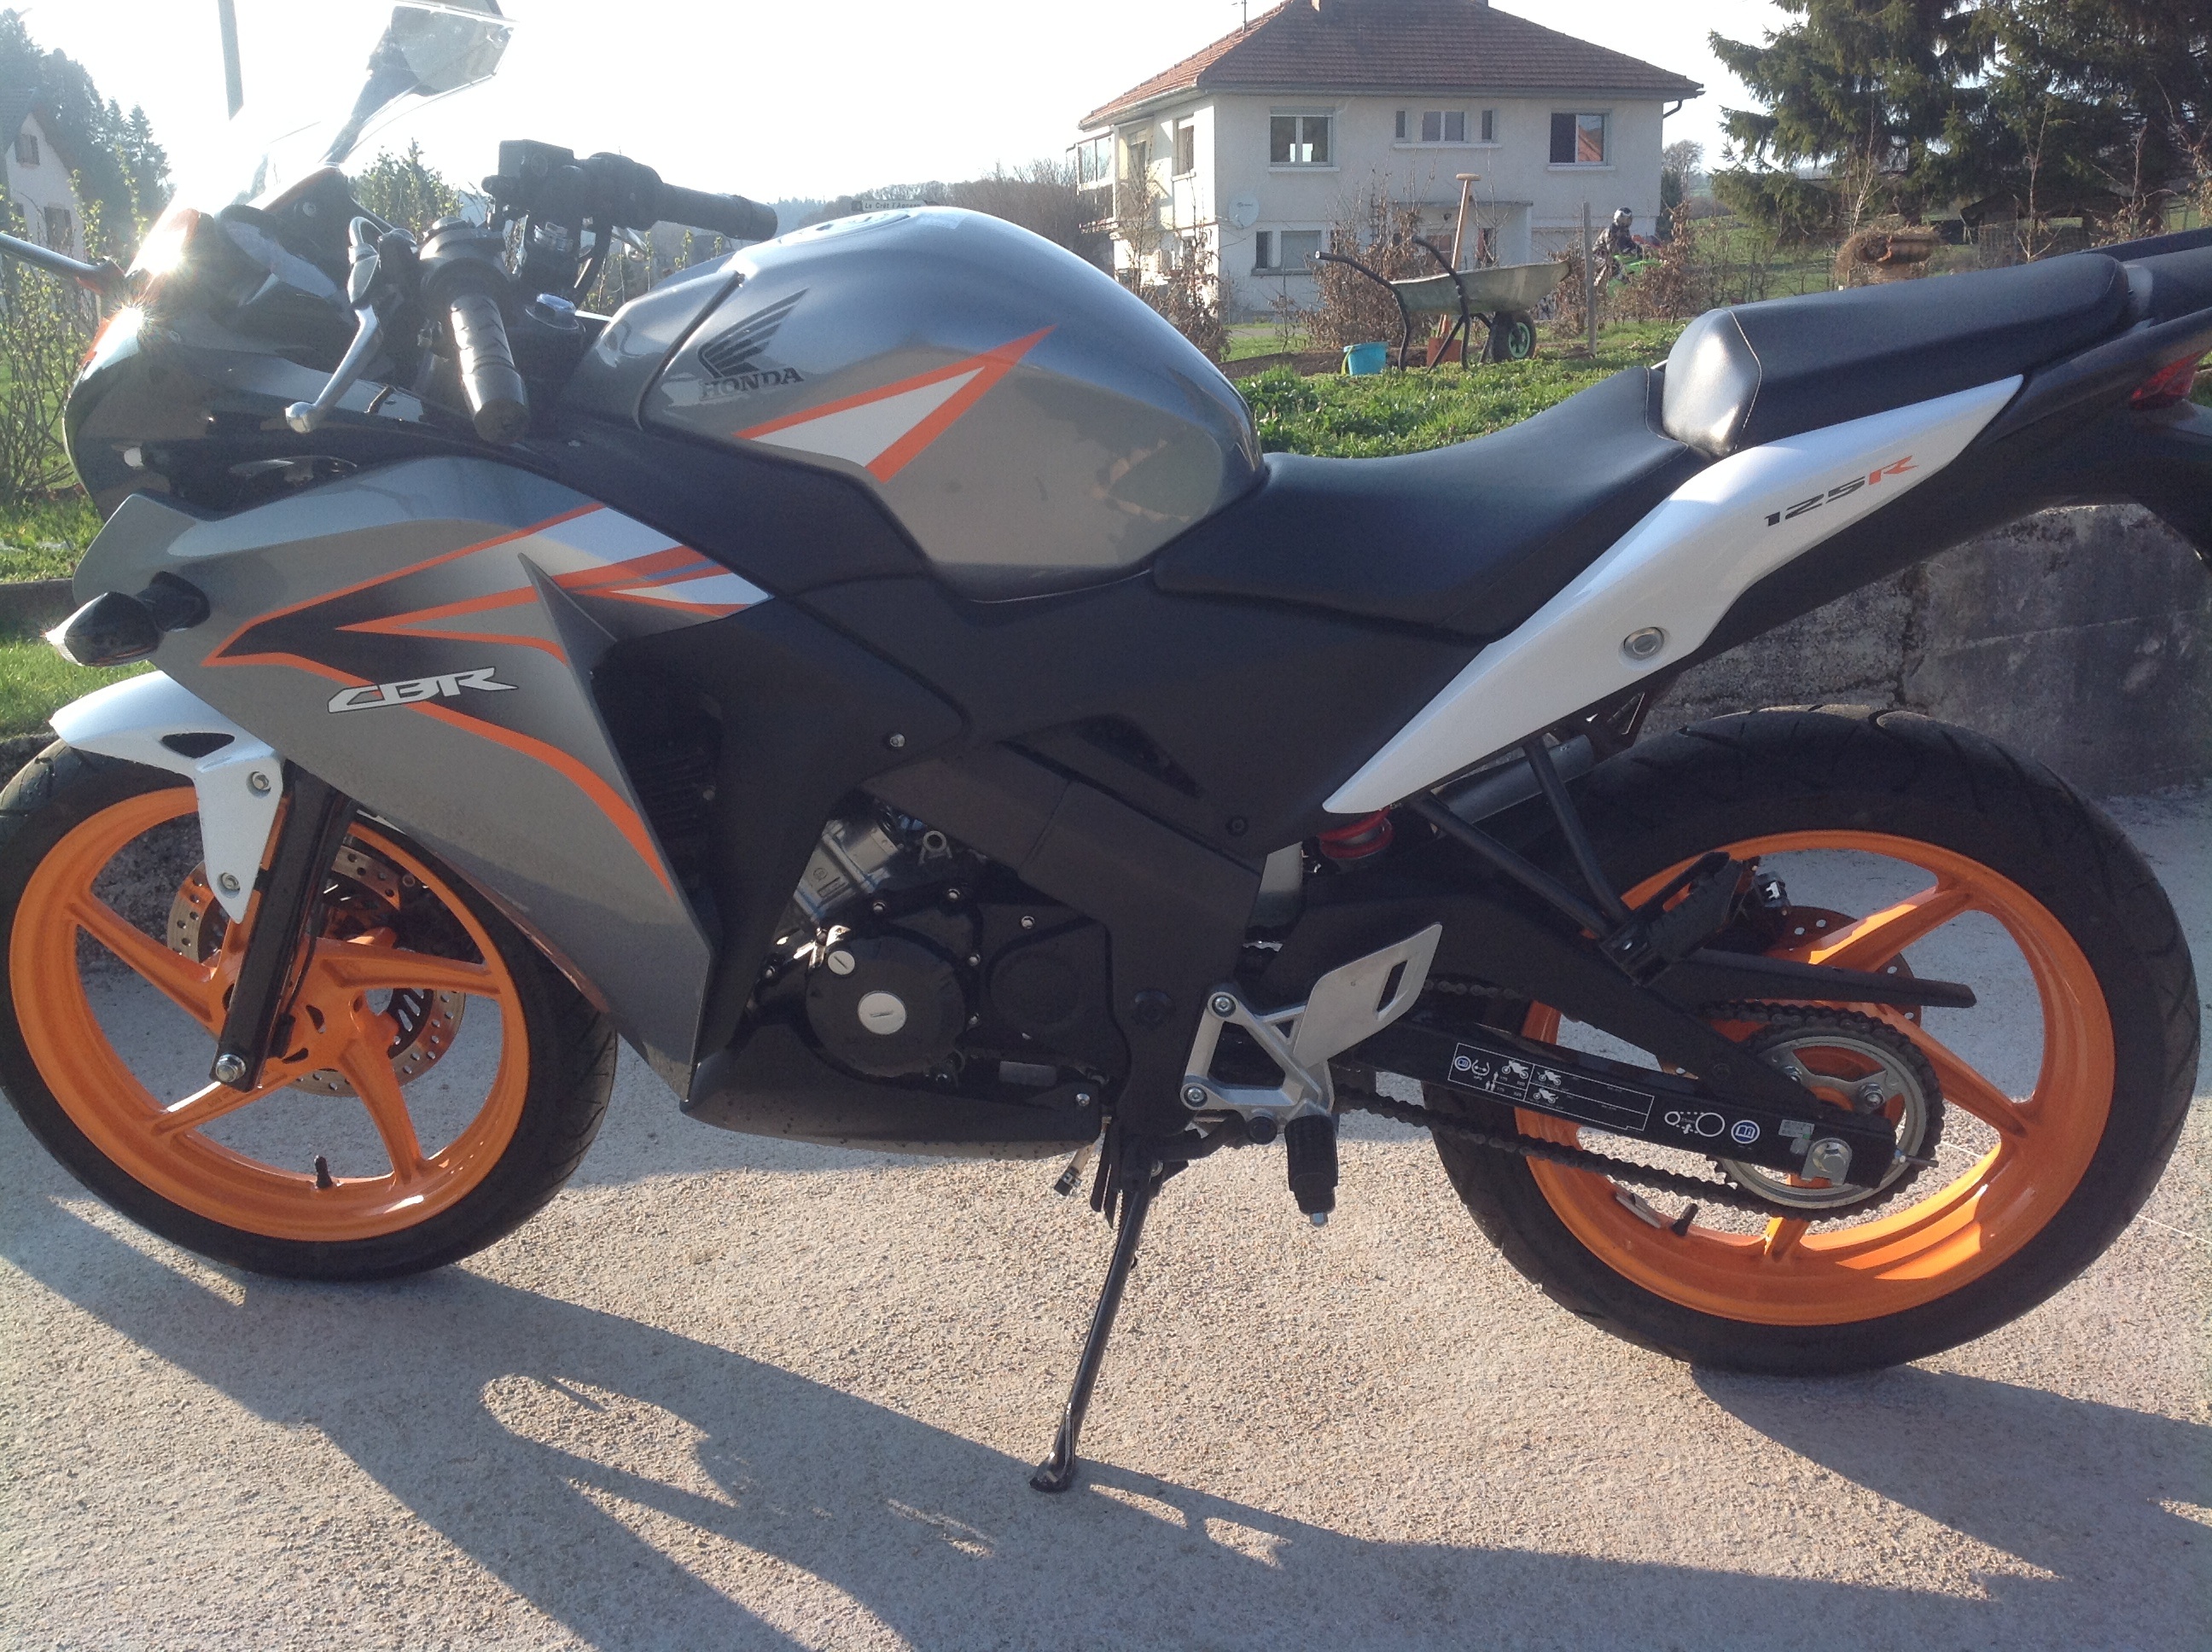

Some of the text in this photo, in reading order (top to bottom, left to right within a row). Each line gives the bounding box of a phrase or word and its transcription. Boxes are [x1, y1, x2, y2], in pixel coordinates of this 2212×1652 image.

[698, 367, 805, 401] HONDA
[1764, 454, 1920, 527] 125R
[326, 666, 519, 713] CBR
